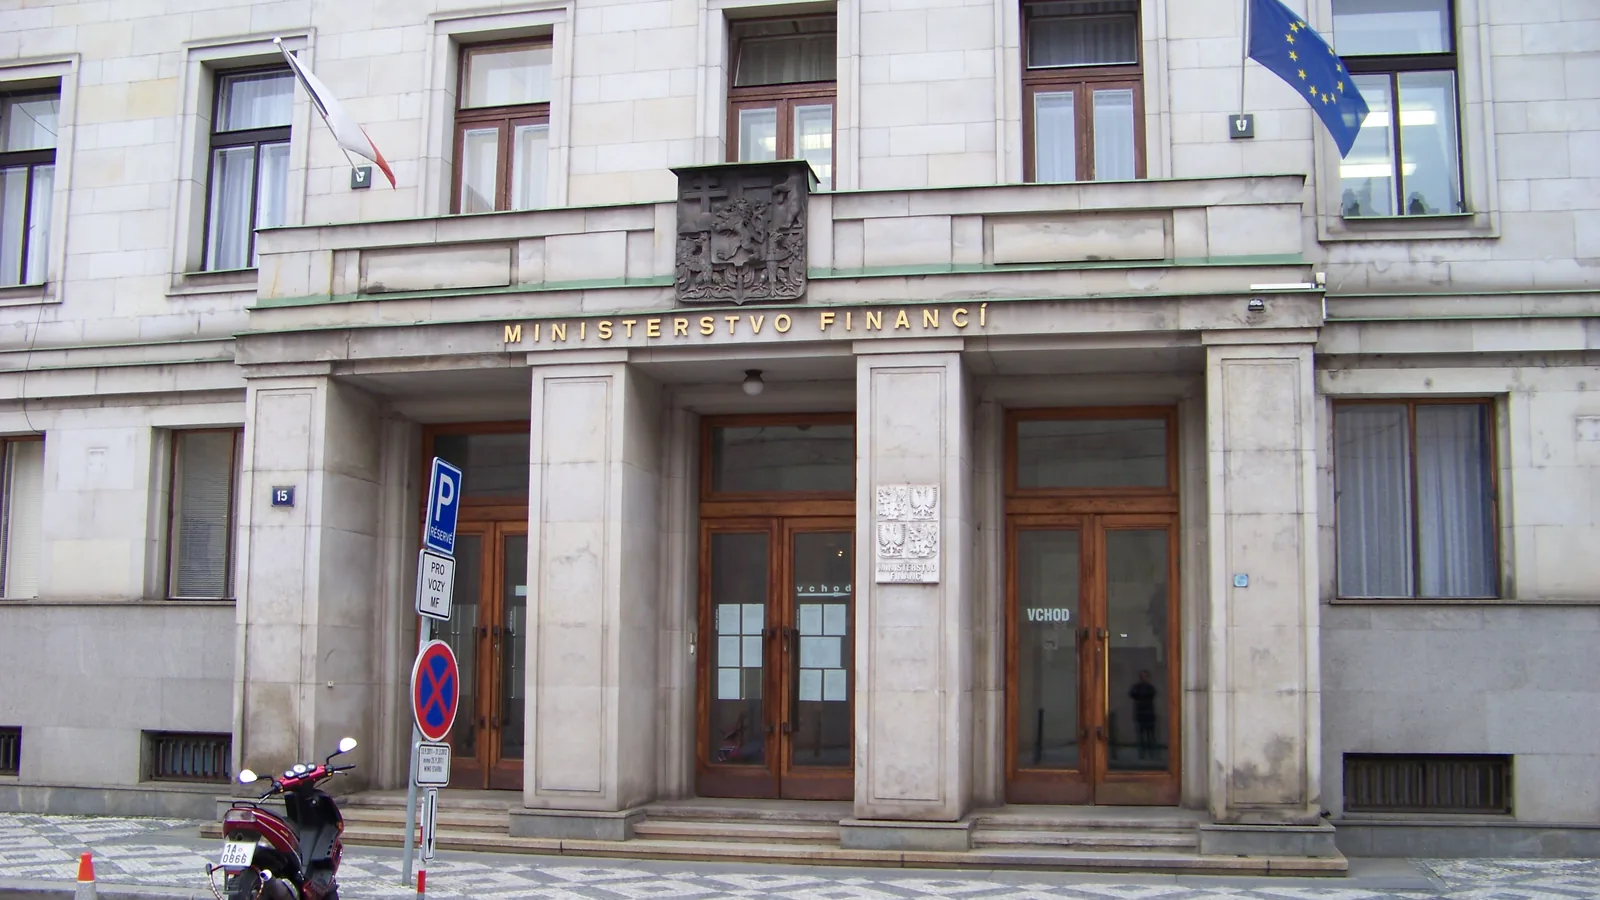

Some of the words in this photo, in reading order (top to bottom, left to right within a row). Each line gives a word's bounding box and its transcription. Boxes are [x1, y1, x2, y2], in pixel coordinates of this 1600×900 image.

[503, 313, 793, 343] MINISTERSTVO
[820, 303, 988, 331] FINANCÍ
[276, 490, 288, 502] 15
[435, 472, 455, 522] P
[430, 526, 453, 545] RÉSERVÉ
[430, 561, 445, 576] PRO
[428, 578, 446, 593] VOZY
[796, 584, 852, 593] vchod
[430, 596, 440, 609] MF
[1027, 608, 1070, 622] VCHOD
